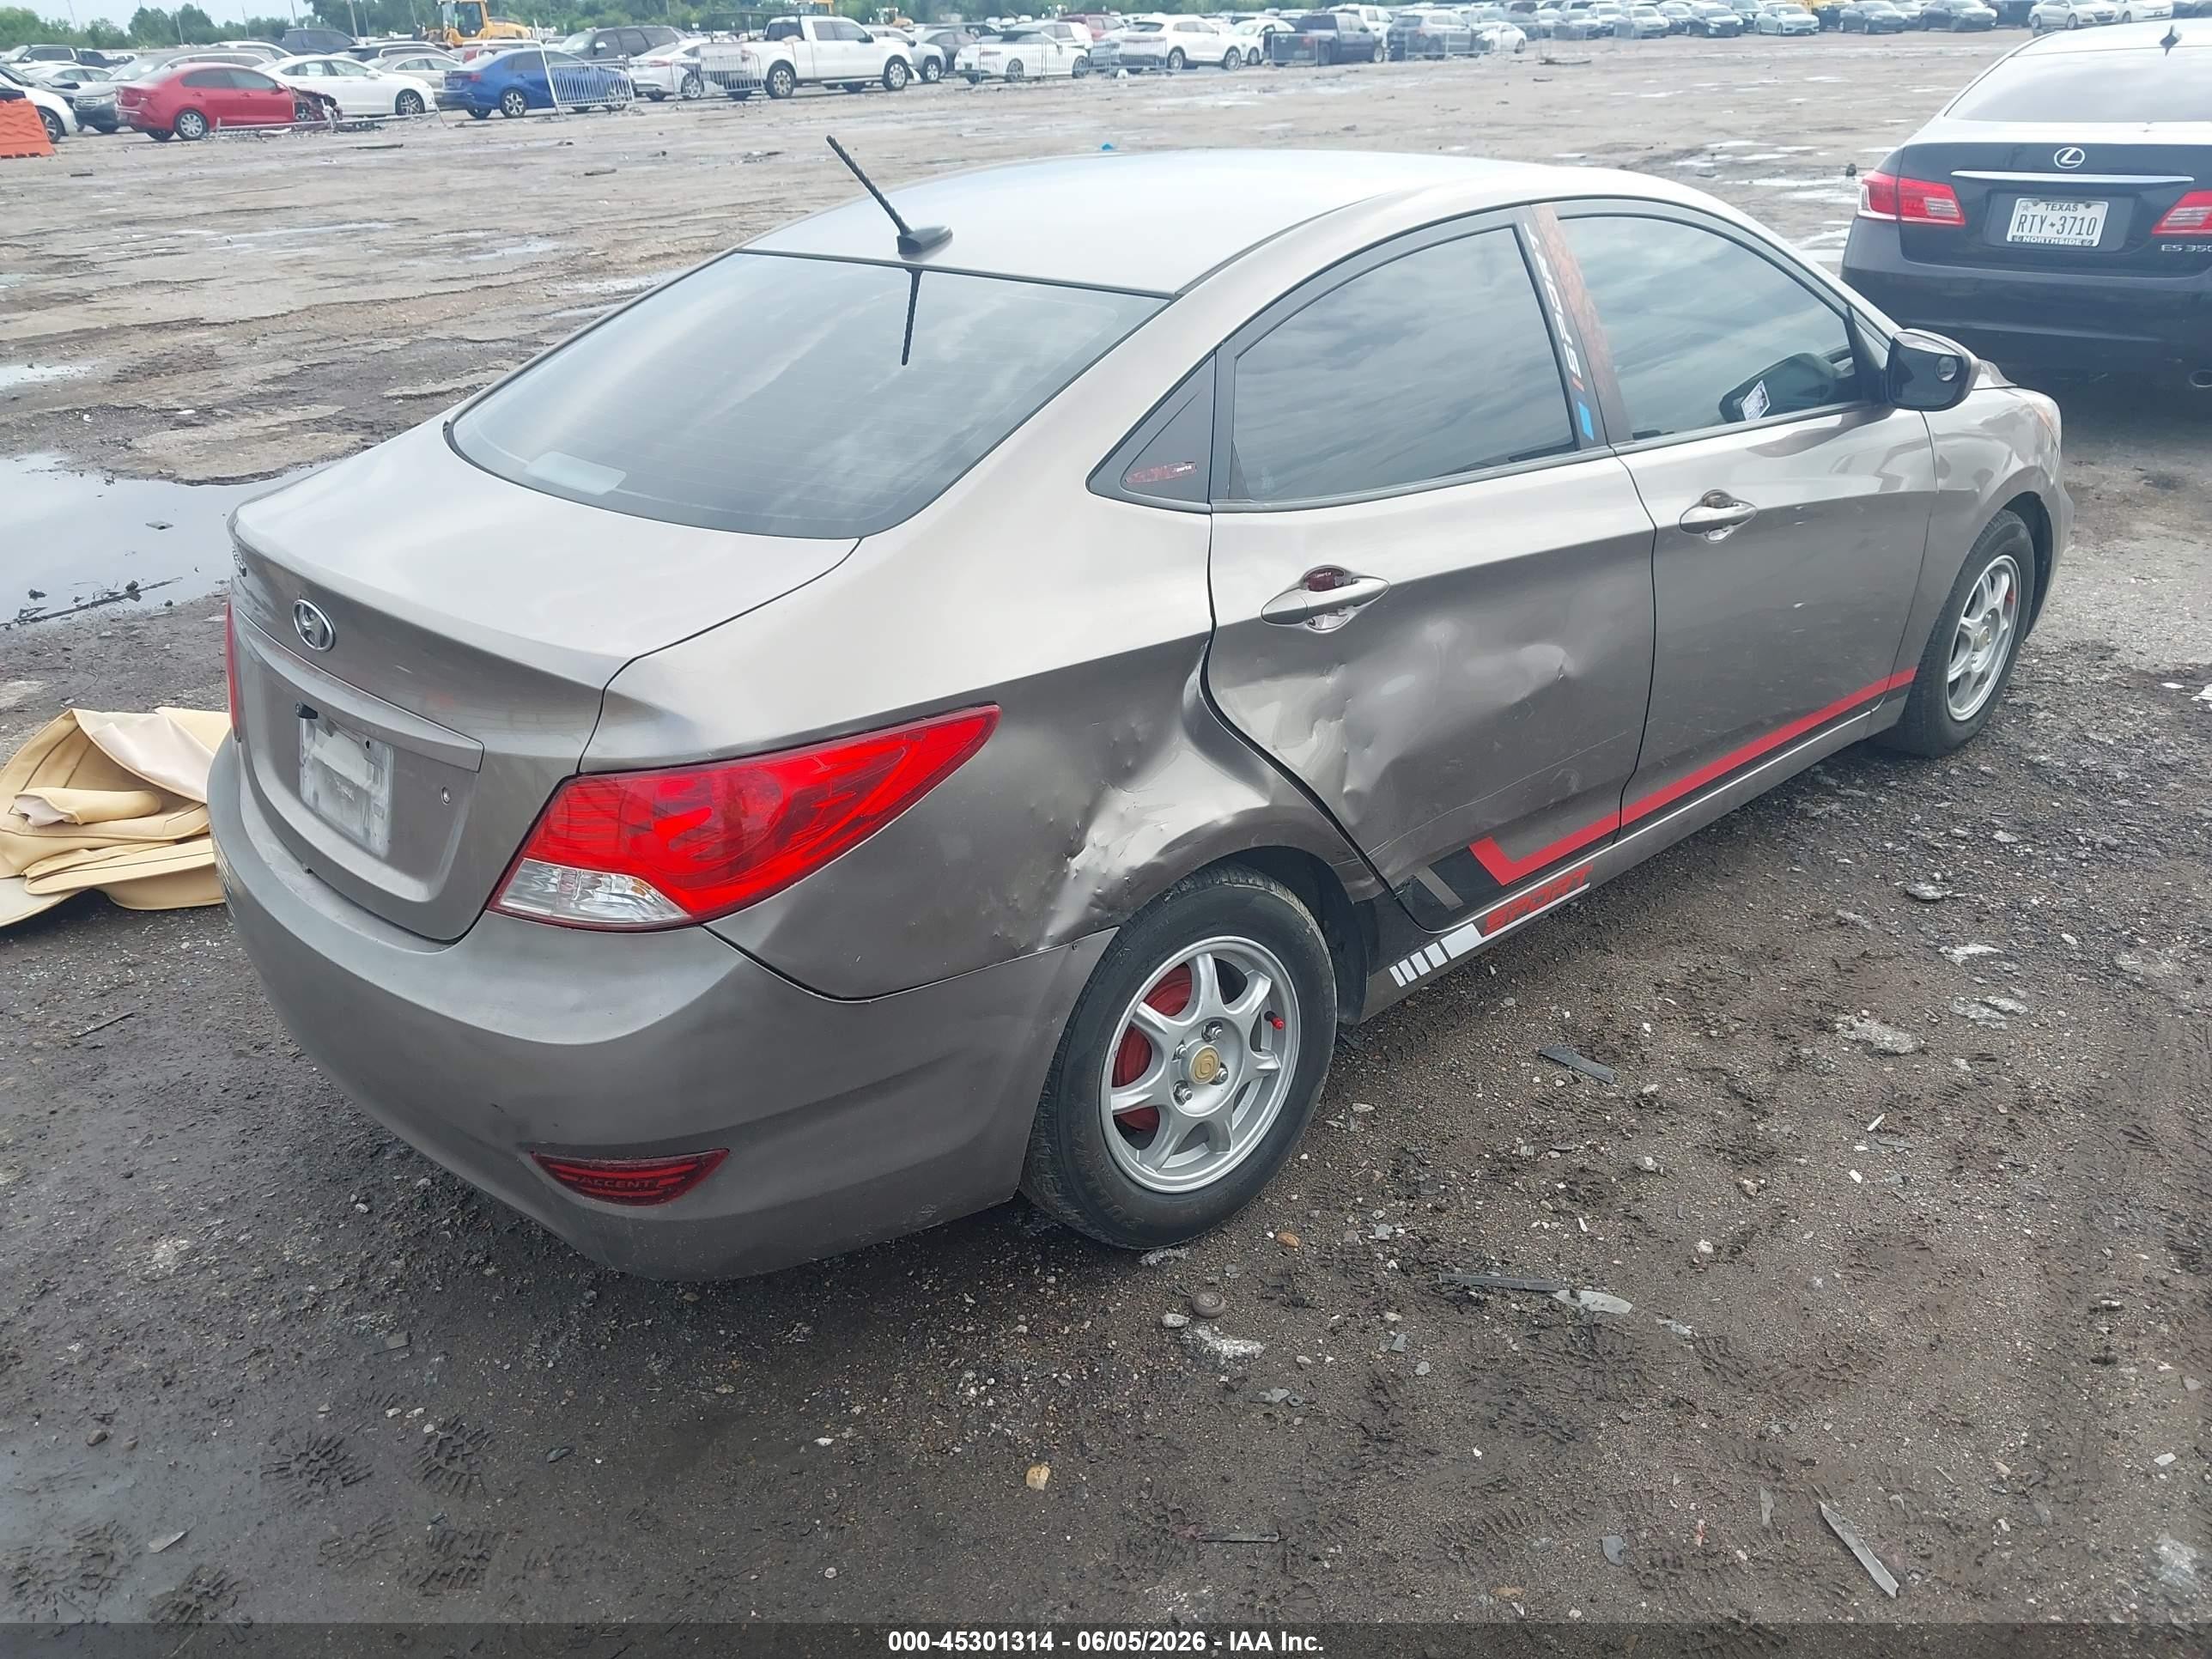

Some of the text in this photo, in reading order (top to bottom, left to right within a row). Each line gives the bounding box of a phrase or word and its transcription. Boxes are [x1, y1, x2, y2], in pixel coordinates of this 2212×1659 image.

[2045, 203, 2079, 212] TEXAS
[2023, 236, 2083, 246] NORTHSIDE
[1484, 863, 1593, 936] SPORT
